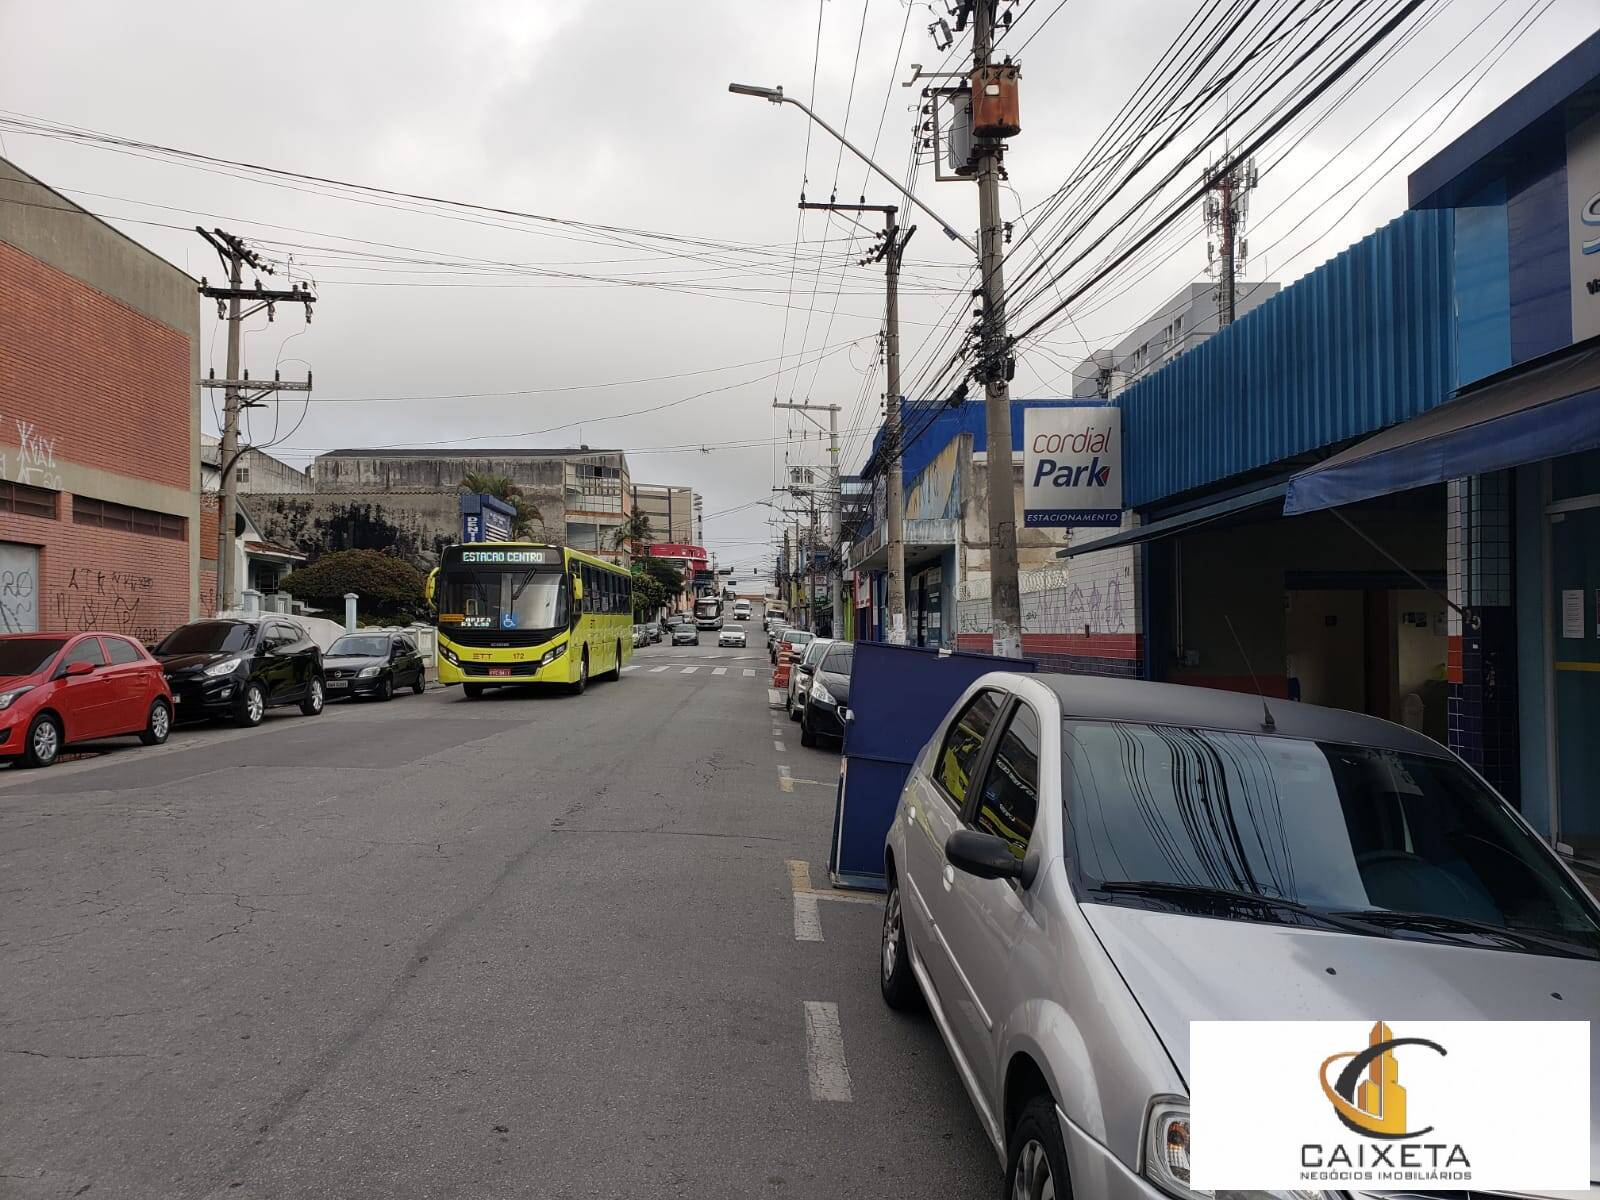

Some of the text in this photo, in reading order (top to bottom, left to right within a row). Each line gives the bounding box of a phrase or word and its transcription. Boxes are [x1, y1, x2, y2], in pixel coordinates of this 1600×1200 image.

[1033, 426, 1112, 453] cordial
[1033, 457, 1110, 487] Park
[1027, 513, 1118, 522] ESTACIONAMENTO
[463, 551, 543, 562] ESTACAO CENTRO
